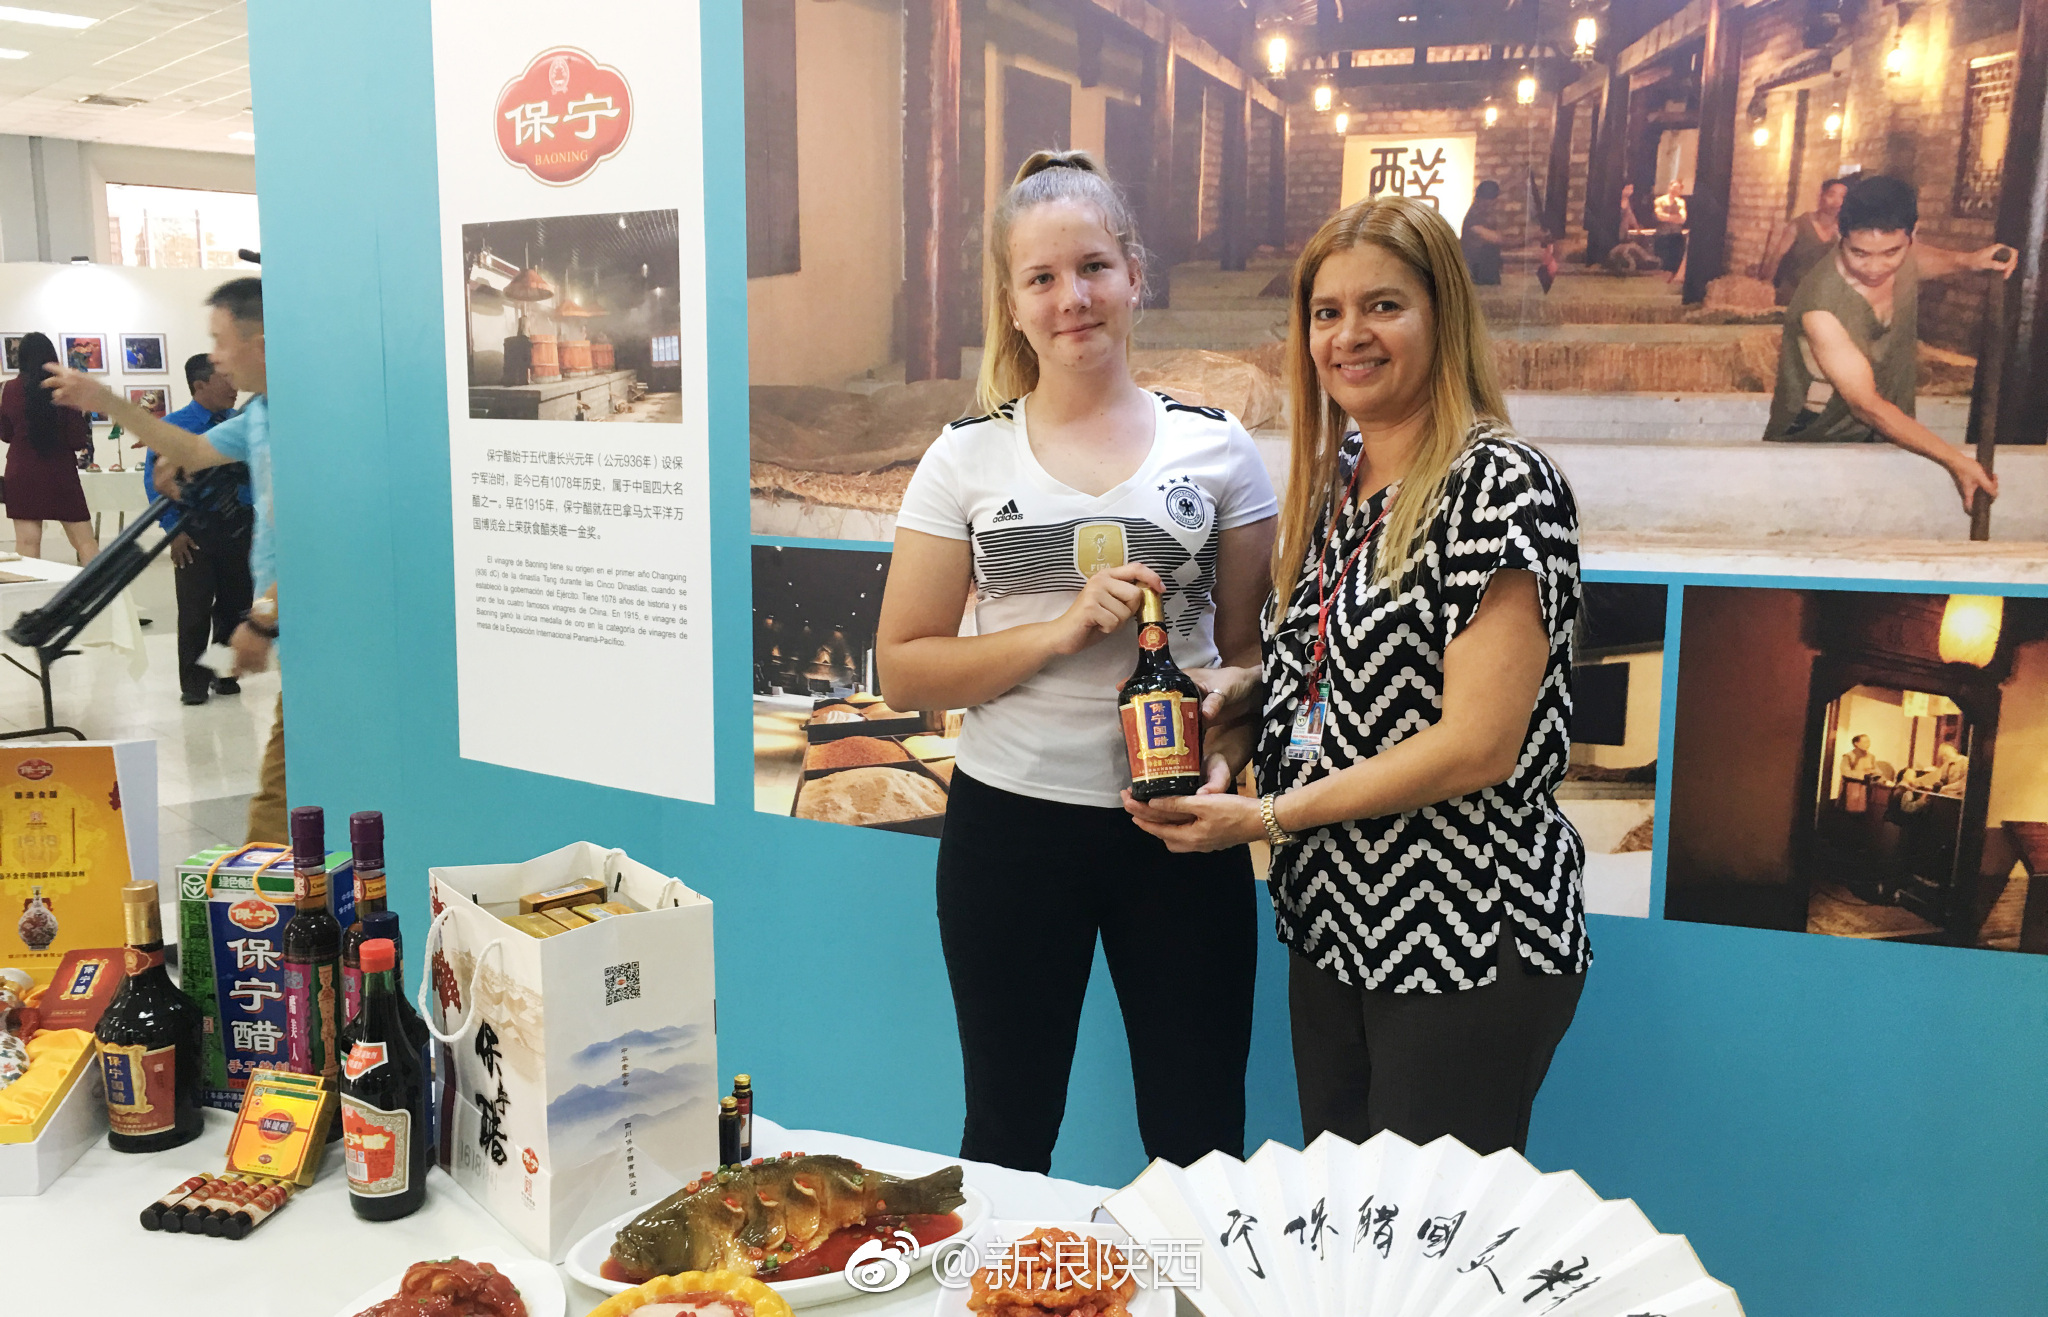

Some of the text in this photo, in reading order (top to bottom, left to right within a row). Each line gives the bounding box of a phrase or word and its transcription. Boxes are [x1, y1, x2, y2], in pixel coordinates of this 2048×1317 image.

[504, 92, 621, 146] 保宁
[534, 149, 589, 166] BAONING
[992, 513, 1024, 524] adidas
[472, 517, 601, 540] 国博览会上荣获食醋类唯一金奖。
[495, 558, 514, 567] vinagre
[525, 559, 548, 570] Baoning
[550, 562, 563, 570] tiene
[576, 566, 594, 574] origen
[616, 569, 635, 577] primer
[652, 571, 687, 583] Changxing
[1090, 562, 1111, 572] FIFA
[543, 575, 557, 585] Tang
[560, 577, 582, 585] durante
[585, 579, 593, 587] las
[597, 580, 614, 589] Cinco
[651, 586, 675, 594] cuando
[546, 589, 554, 597] del
[582, 592, 598, 601] Tiene
[601, 594, 616, 603] 1078
[648, 600, 669, 608] historia
[497, 597, 505, 605] los
[526, 600, 550, 610] famosos
[552, 604, 576, 614] vinagres
[579, 606, 586, 614] de
[589, 607, 608, 616] China.
[624, 611, 641, 620] 1915,
[652, 615, 676, 625] vinagre
[679, 617, 687, 625] de
[476, 608, 498, 618] Baoning
[540, 615, 562, 625] medalla
[574, 620, 585, 628] oro
[598, 622, 603, 630] la
[638, 627, 647, 635] de
[649, 629, 676, 639] vinagres
[500, 623, 505, 631] la
[536, 629, 572, 640] Internacional
[231, 908, 277, 922] 保宁
[226, 937, 285, 1054] 保宁醋
